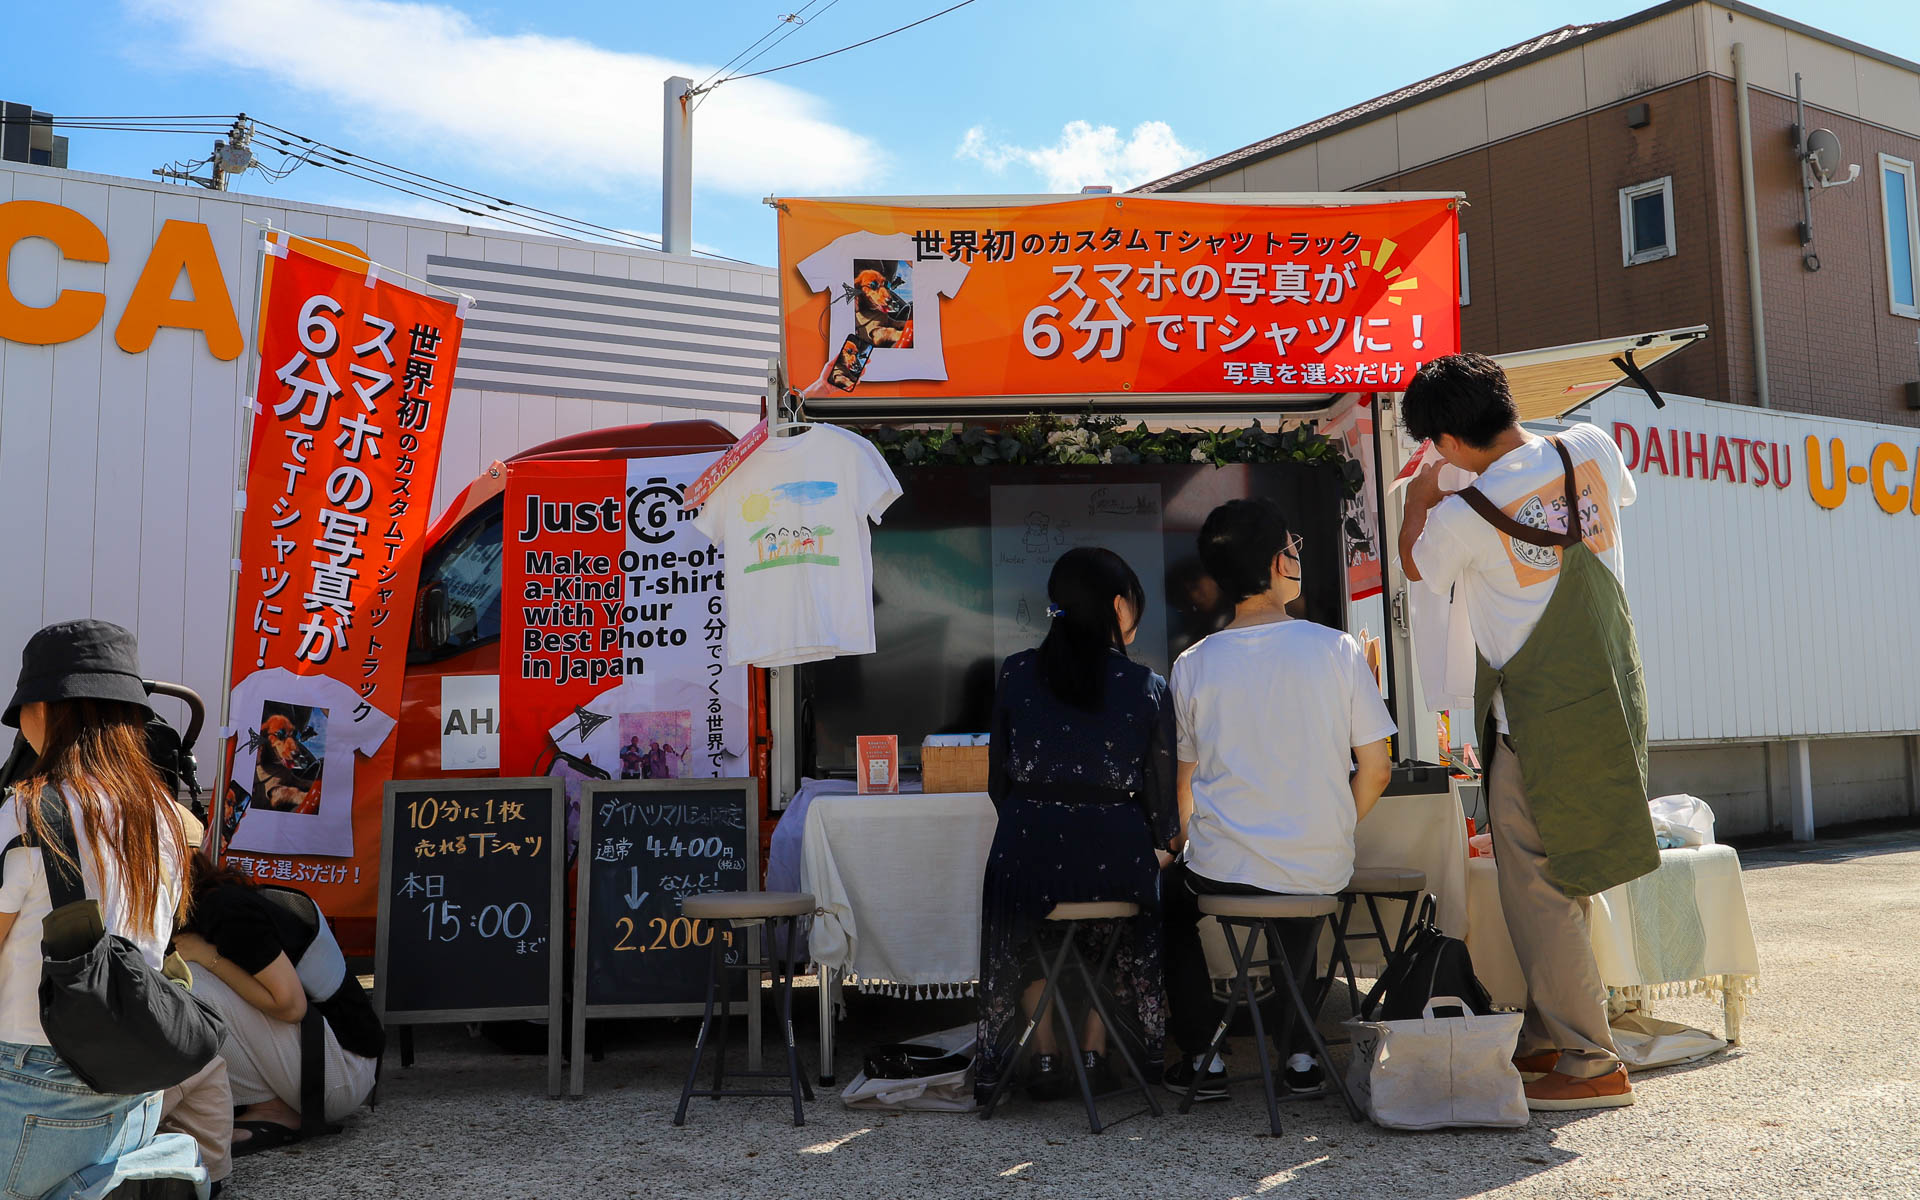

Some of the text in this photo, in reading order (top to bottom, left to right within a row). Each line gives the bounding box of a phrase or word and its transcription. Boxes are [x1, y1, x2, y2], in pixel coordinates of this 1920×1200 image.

[0, 199, 372, 362] CA
[1048, 260, 1358, 304] スマホの写真が
[1612, 421, 1792, 489] DAIHATSU
[295, 313, 396, 664] スマホの写真が
[519, 495, 621, 542] Just
[647, 501, 667, 528] 6
[525, 550, 611, 575] Make
[524, 570, 725, 601] a-Kind T-shirt
[522, 601, 673, 626] with Your
[523, 625, 687, 652] Best Photo
[522, 653, 645, 686] in Japan
[443, 708, 500, 735] AH
[407, 797, 526, 830] 10分に1枚
[414, 832, 543, 859] 売れるTシャツ
[595, 838, 633, 862] 通常
[397, 872, 445, 898] 本日
[658, 871, 720, 891] なんと!
[422, 900, 532, 942] 15:00
[516, 938, 546, 955] まで
